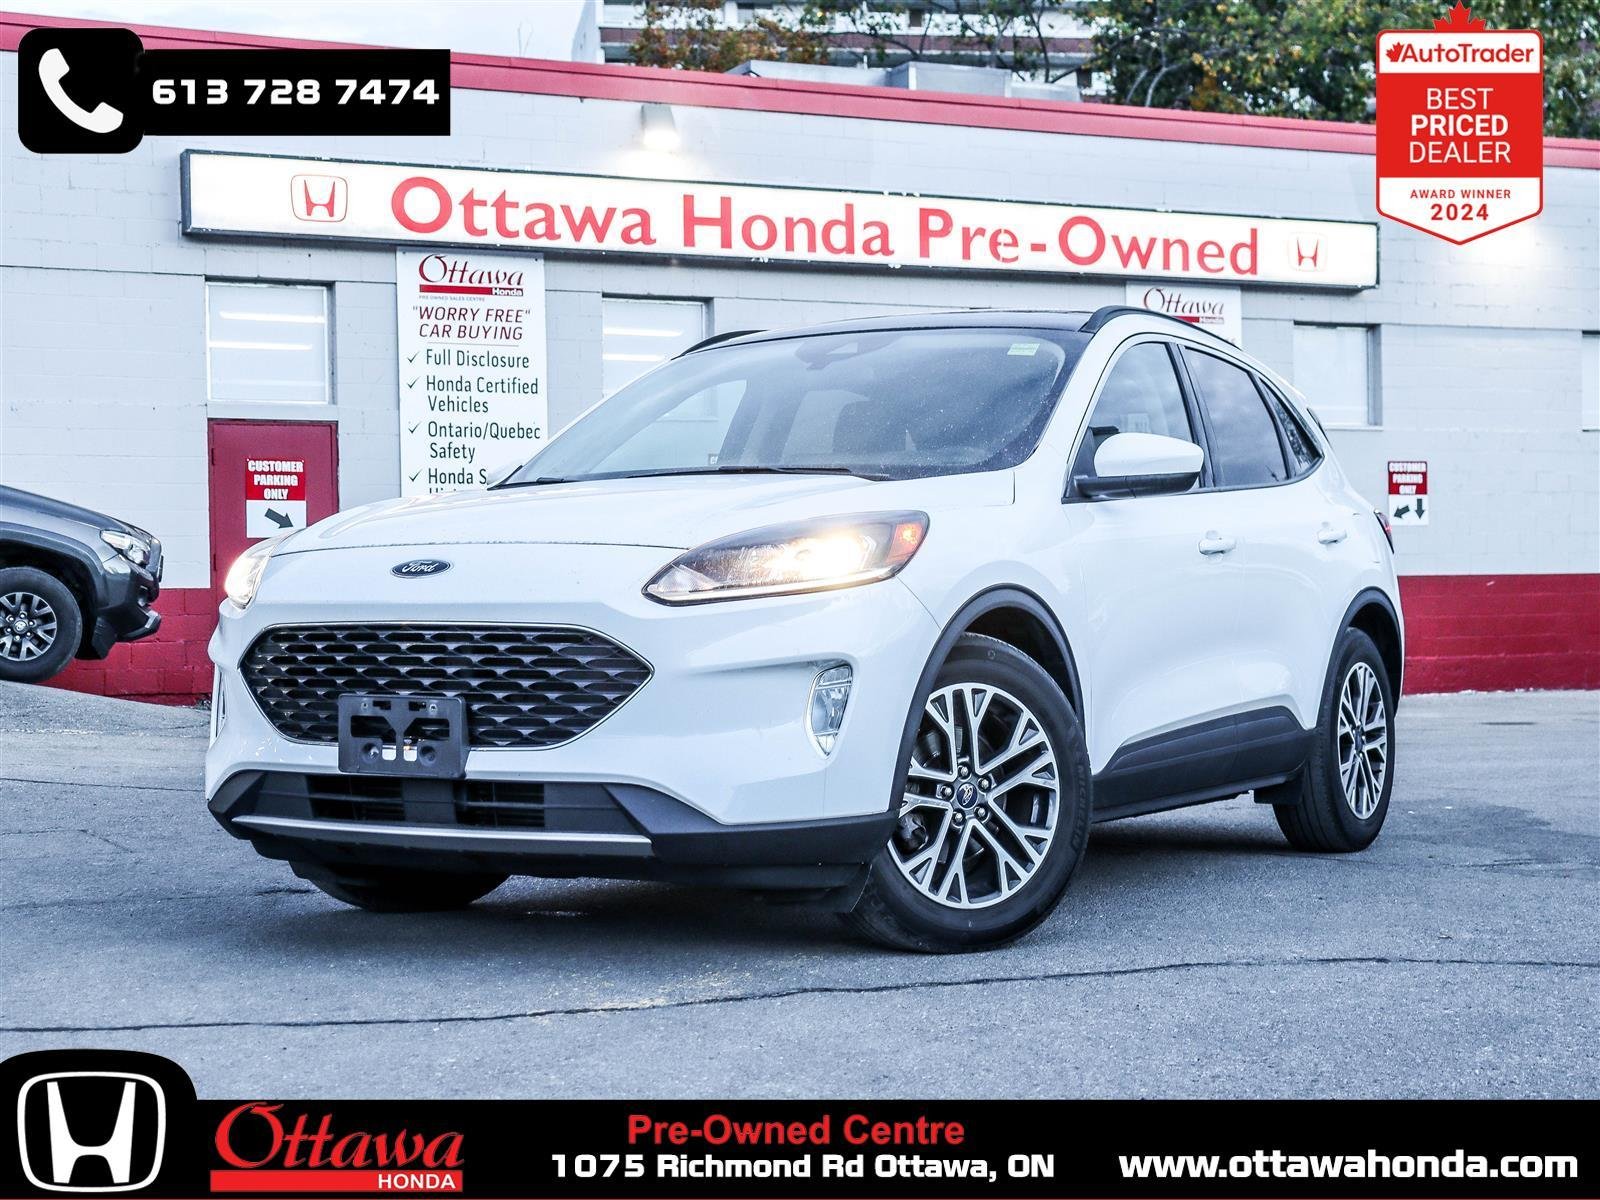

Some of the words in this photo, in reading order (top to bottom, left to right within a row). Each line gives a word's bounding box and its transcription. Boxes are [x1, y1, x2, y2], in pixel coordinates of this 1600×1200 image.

[391, 176, 657, 246] Ottawa
[683, 194, 895, 257] Honda
[918, 207, 1259, 275] Pre-Owned
[418, 253, 524, 286] Ottawa
[492, 287, 523, 297] Honda
[1143, 287, 1224, 315] Ottawa
[419, 323, 451, 338] CAR
[457, 325, 523, 341] BUYING
[426, 349, 451, 366] Full
[456, 350, 530, 368] Disclosure
[426, 375, 472, 392] Honda
[476, 376, 539, 394] Certified
[428, 395, 489, 413] Vehicles
[428, 420, 541, 440] Ontario/Quebec
[430, 442, 476, 464] Safety
[247, 460, 304, 473] CUSTOMER
[253, 474, 299, 487] PARKING
[428, 467, 474, 485] Honda
[263, 488, 289, 500] ONLY
[402, 560, 439, 573] Ford
